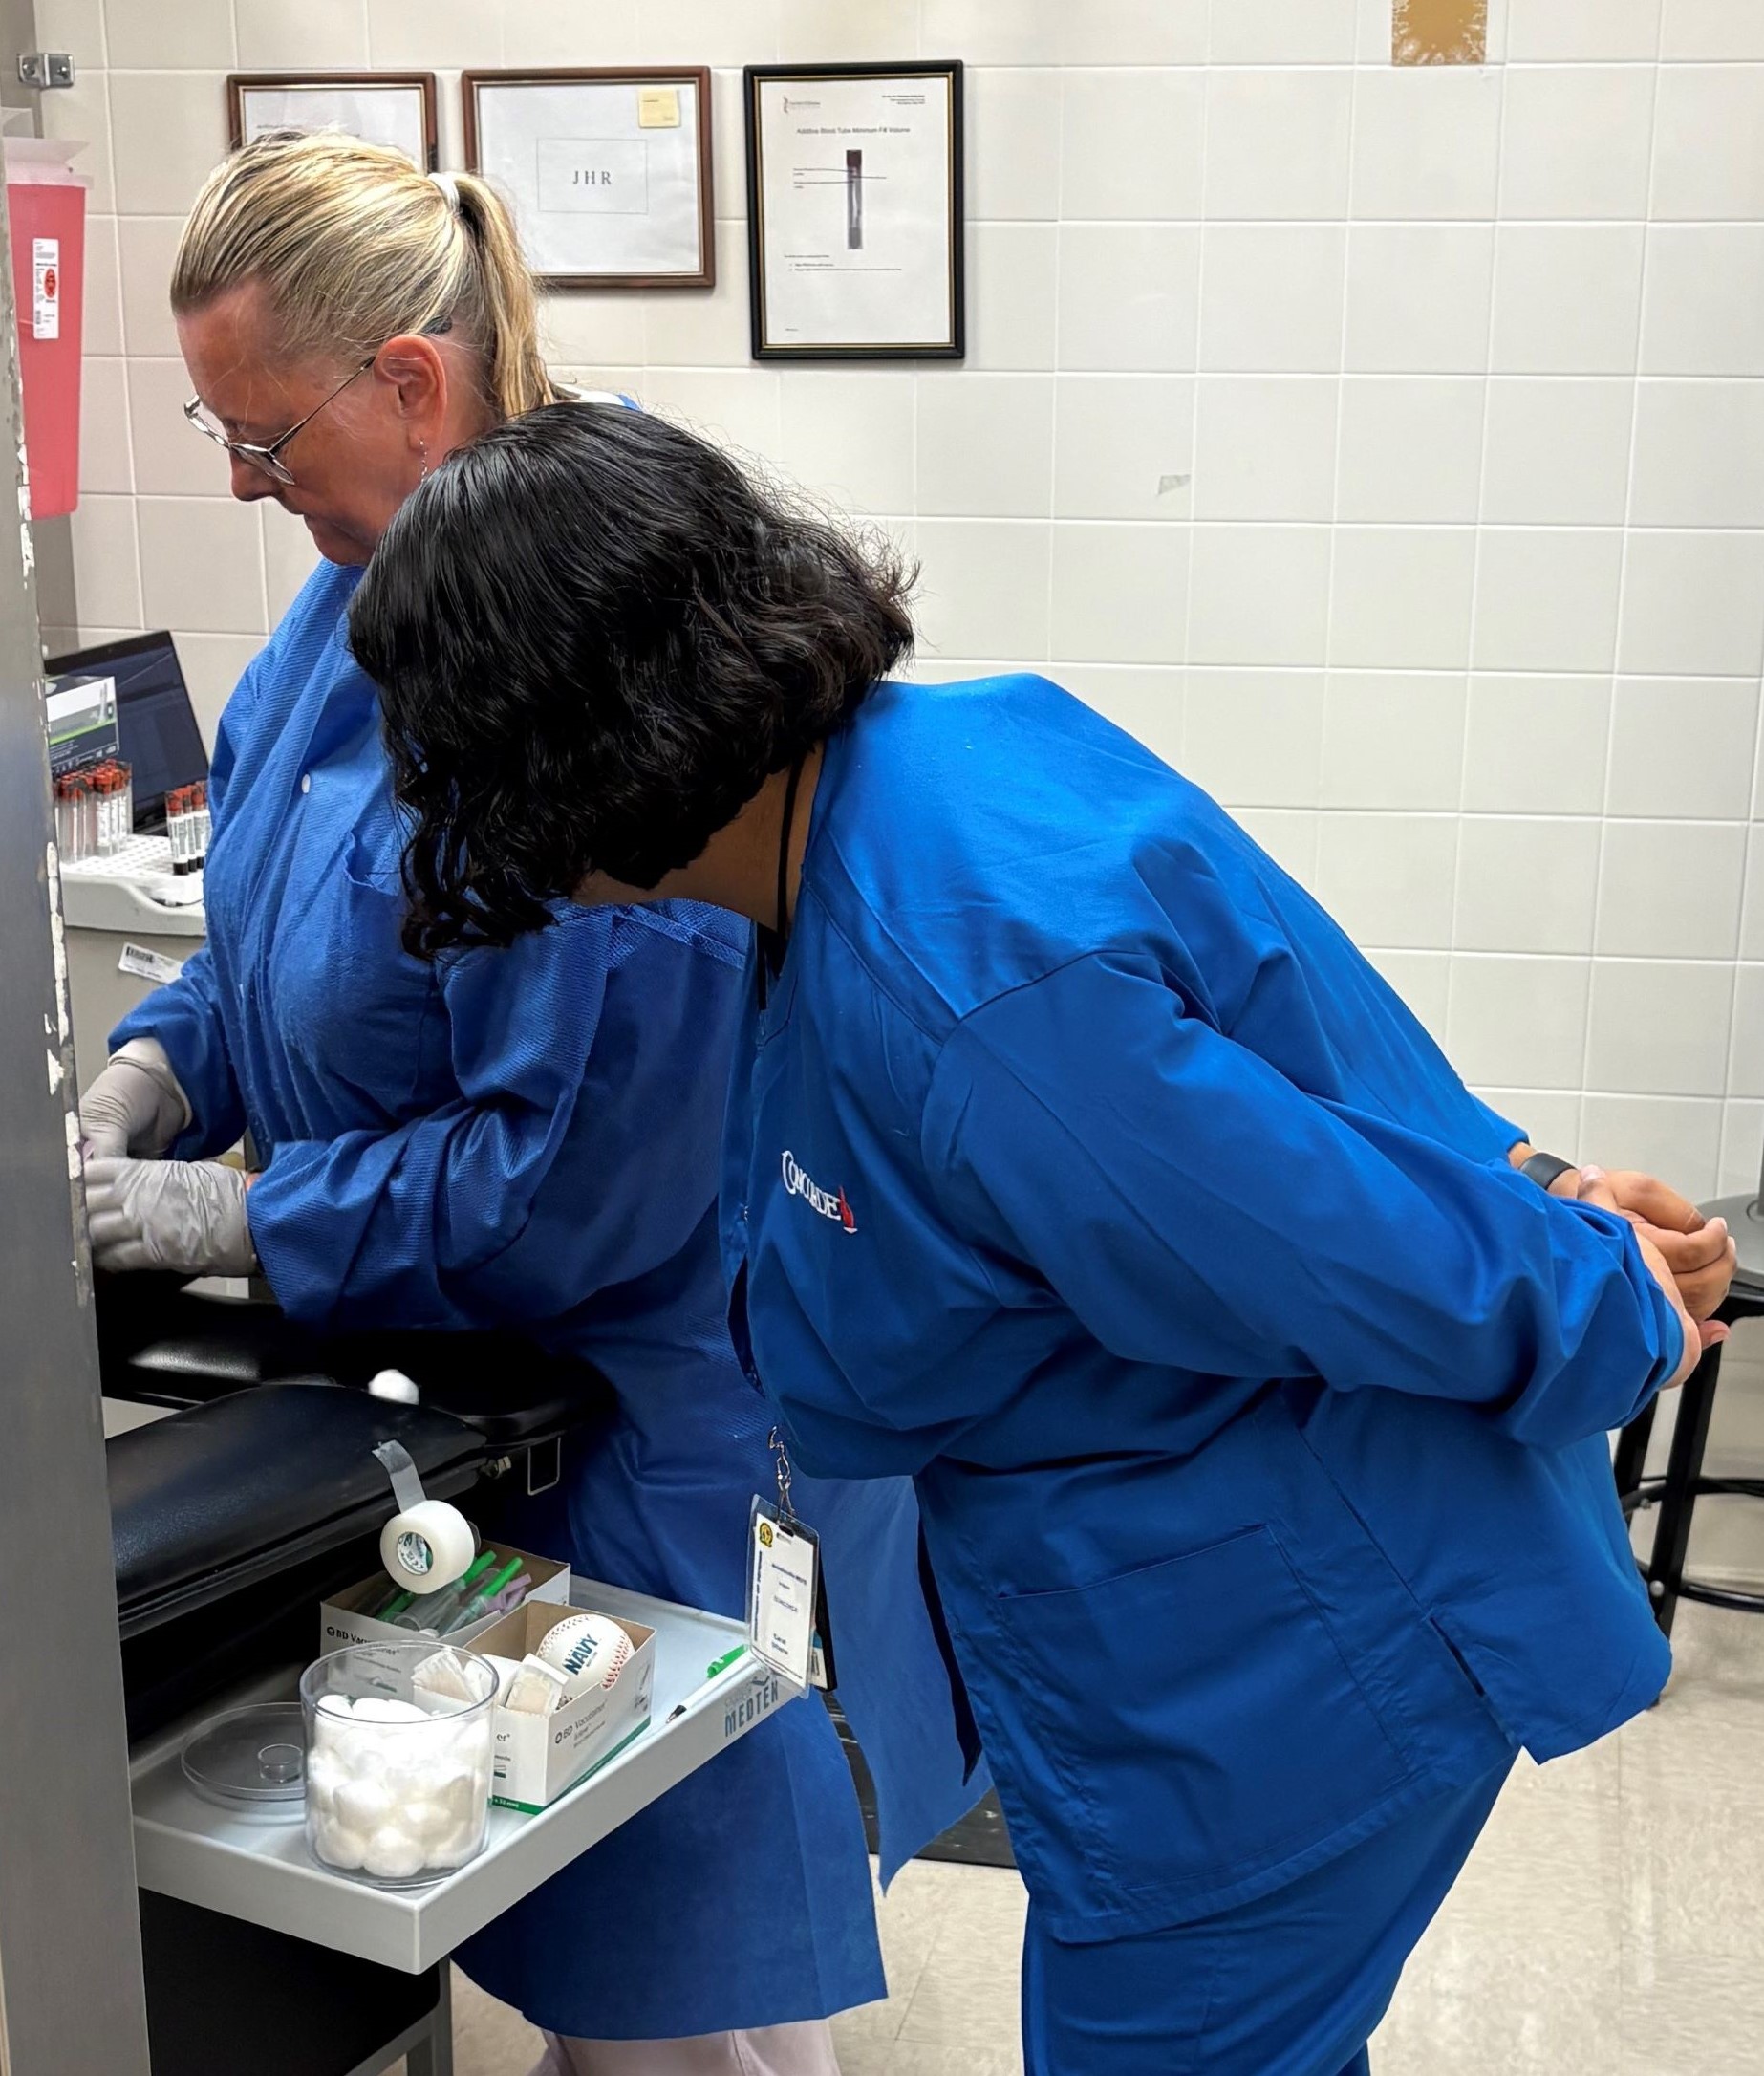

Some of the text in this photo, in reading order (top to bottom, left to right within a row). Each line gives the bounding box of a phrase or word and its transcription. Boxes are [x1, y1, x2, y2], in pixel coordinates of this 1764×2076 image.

[572, 170, 612, 184] JHR
[336, 1629, 349, 1640] BD
[562, 1633, 598, 1676] NAVY
[563, 1725, 573, 1739] BD
